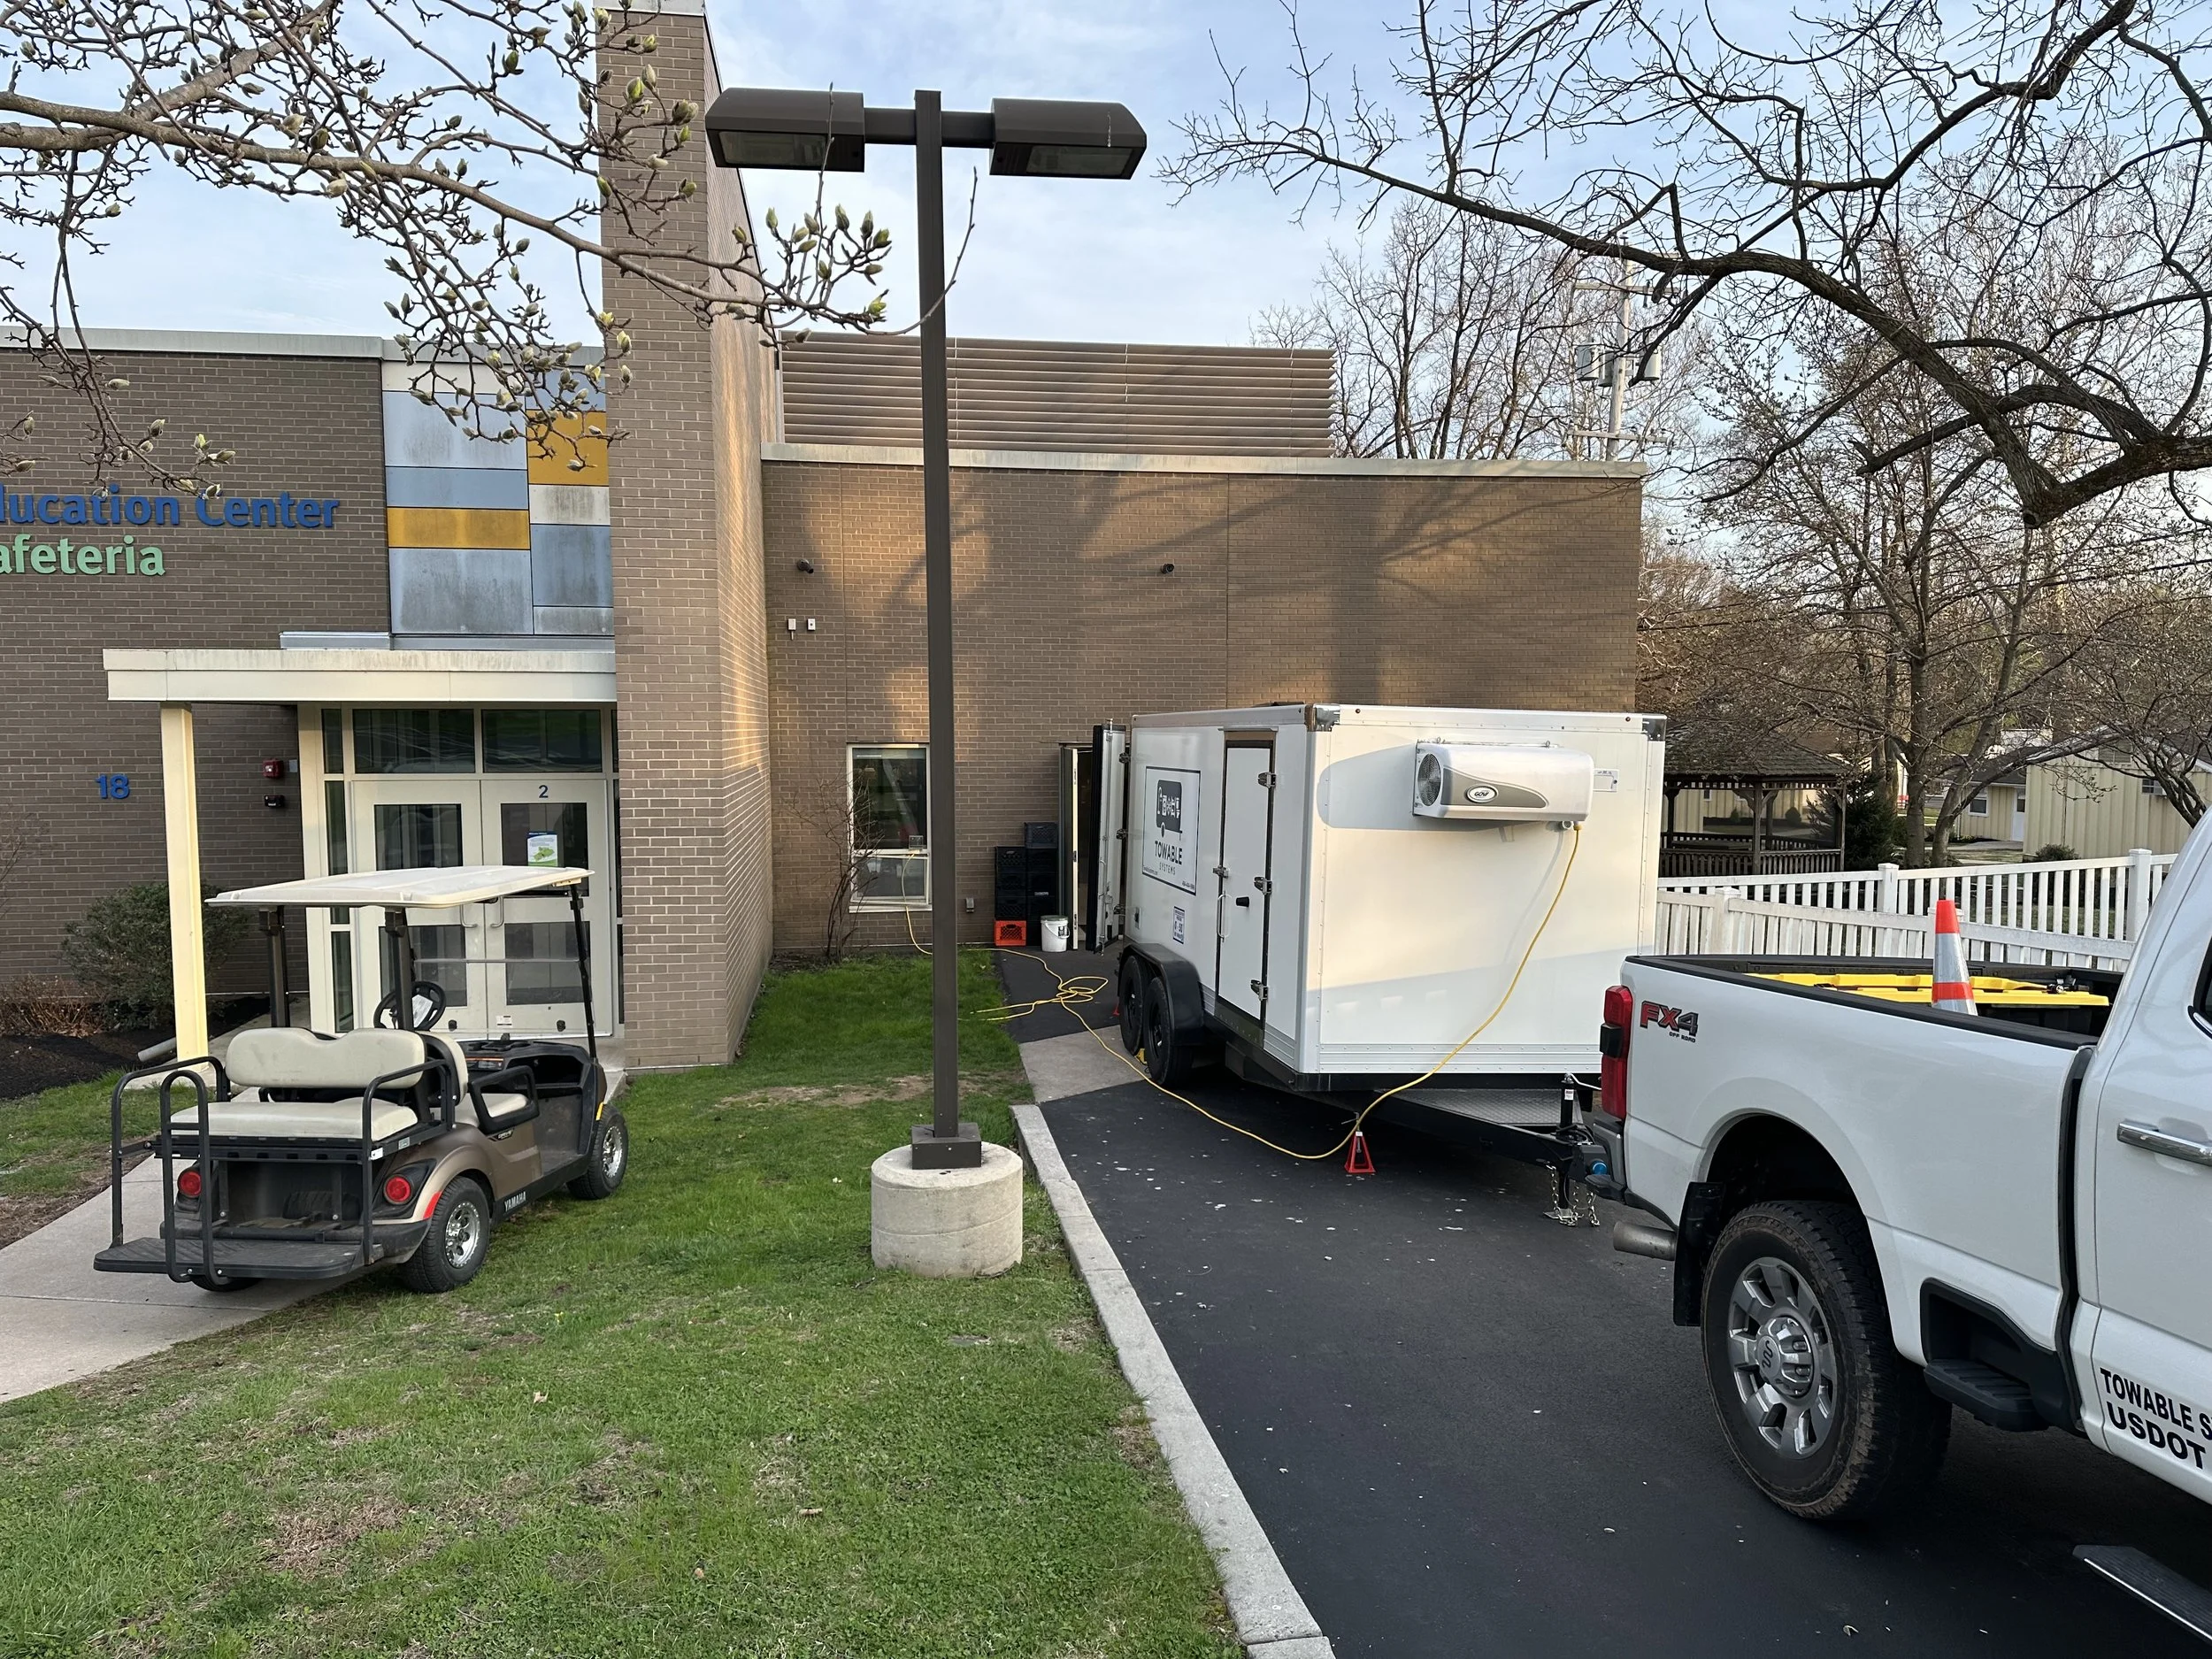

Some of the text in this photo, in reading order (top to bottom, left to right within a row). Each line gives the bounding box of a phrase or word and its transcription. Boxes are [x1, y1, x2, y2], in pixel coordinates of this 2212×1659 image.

[0, 481, 341, 527] ucation Center
[96, 774, 130, 799] 18
[538, 784, 549, 798] 2
[1155, 841, 1182, 864] TOWABLE
[1159, 862, 1176, 875] SYSTEMS
[1640, 1000, 1699, 1037] FX4
[1681, 1034, 1696, 1043] ROAD
[504, 1191, 526, 1212] YAMAHA
[2100, 1367, 2195, 1433] TOWABLE
[2106, 1401, 2207, 1470] USDOT
